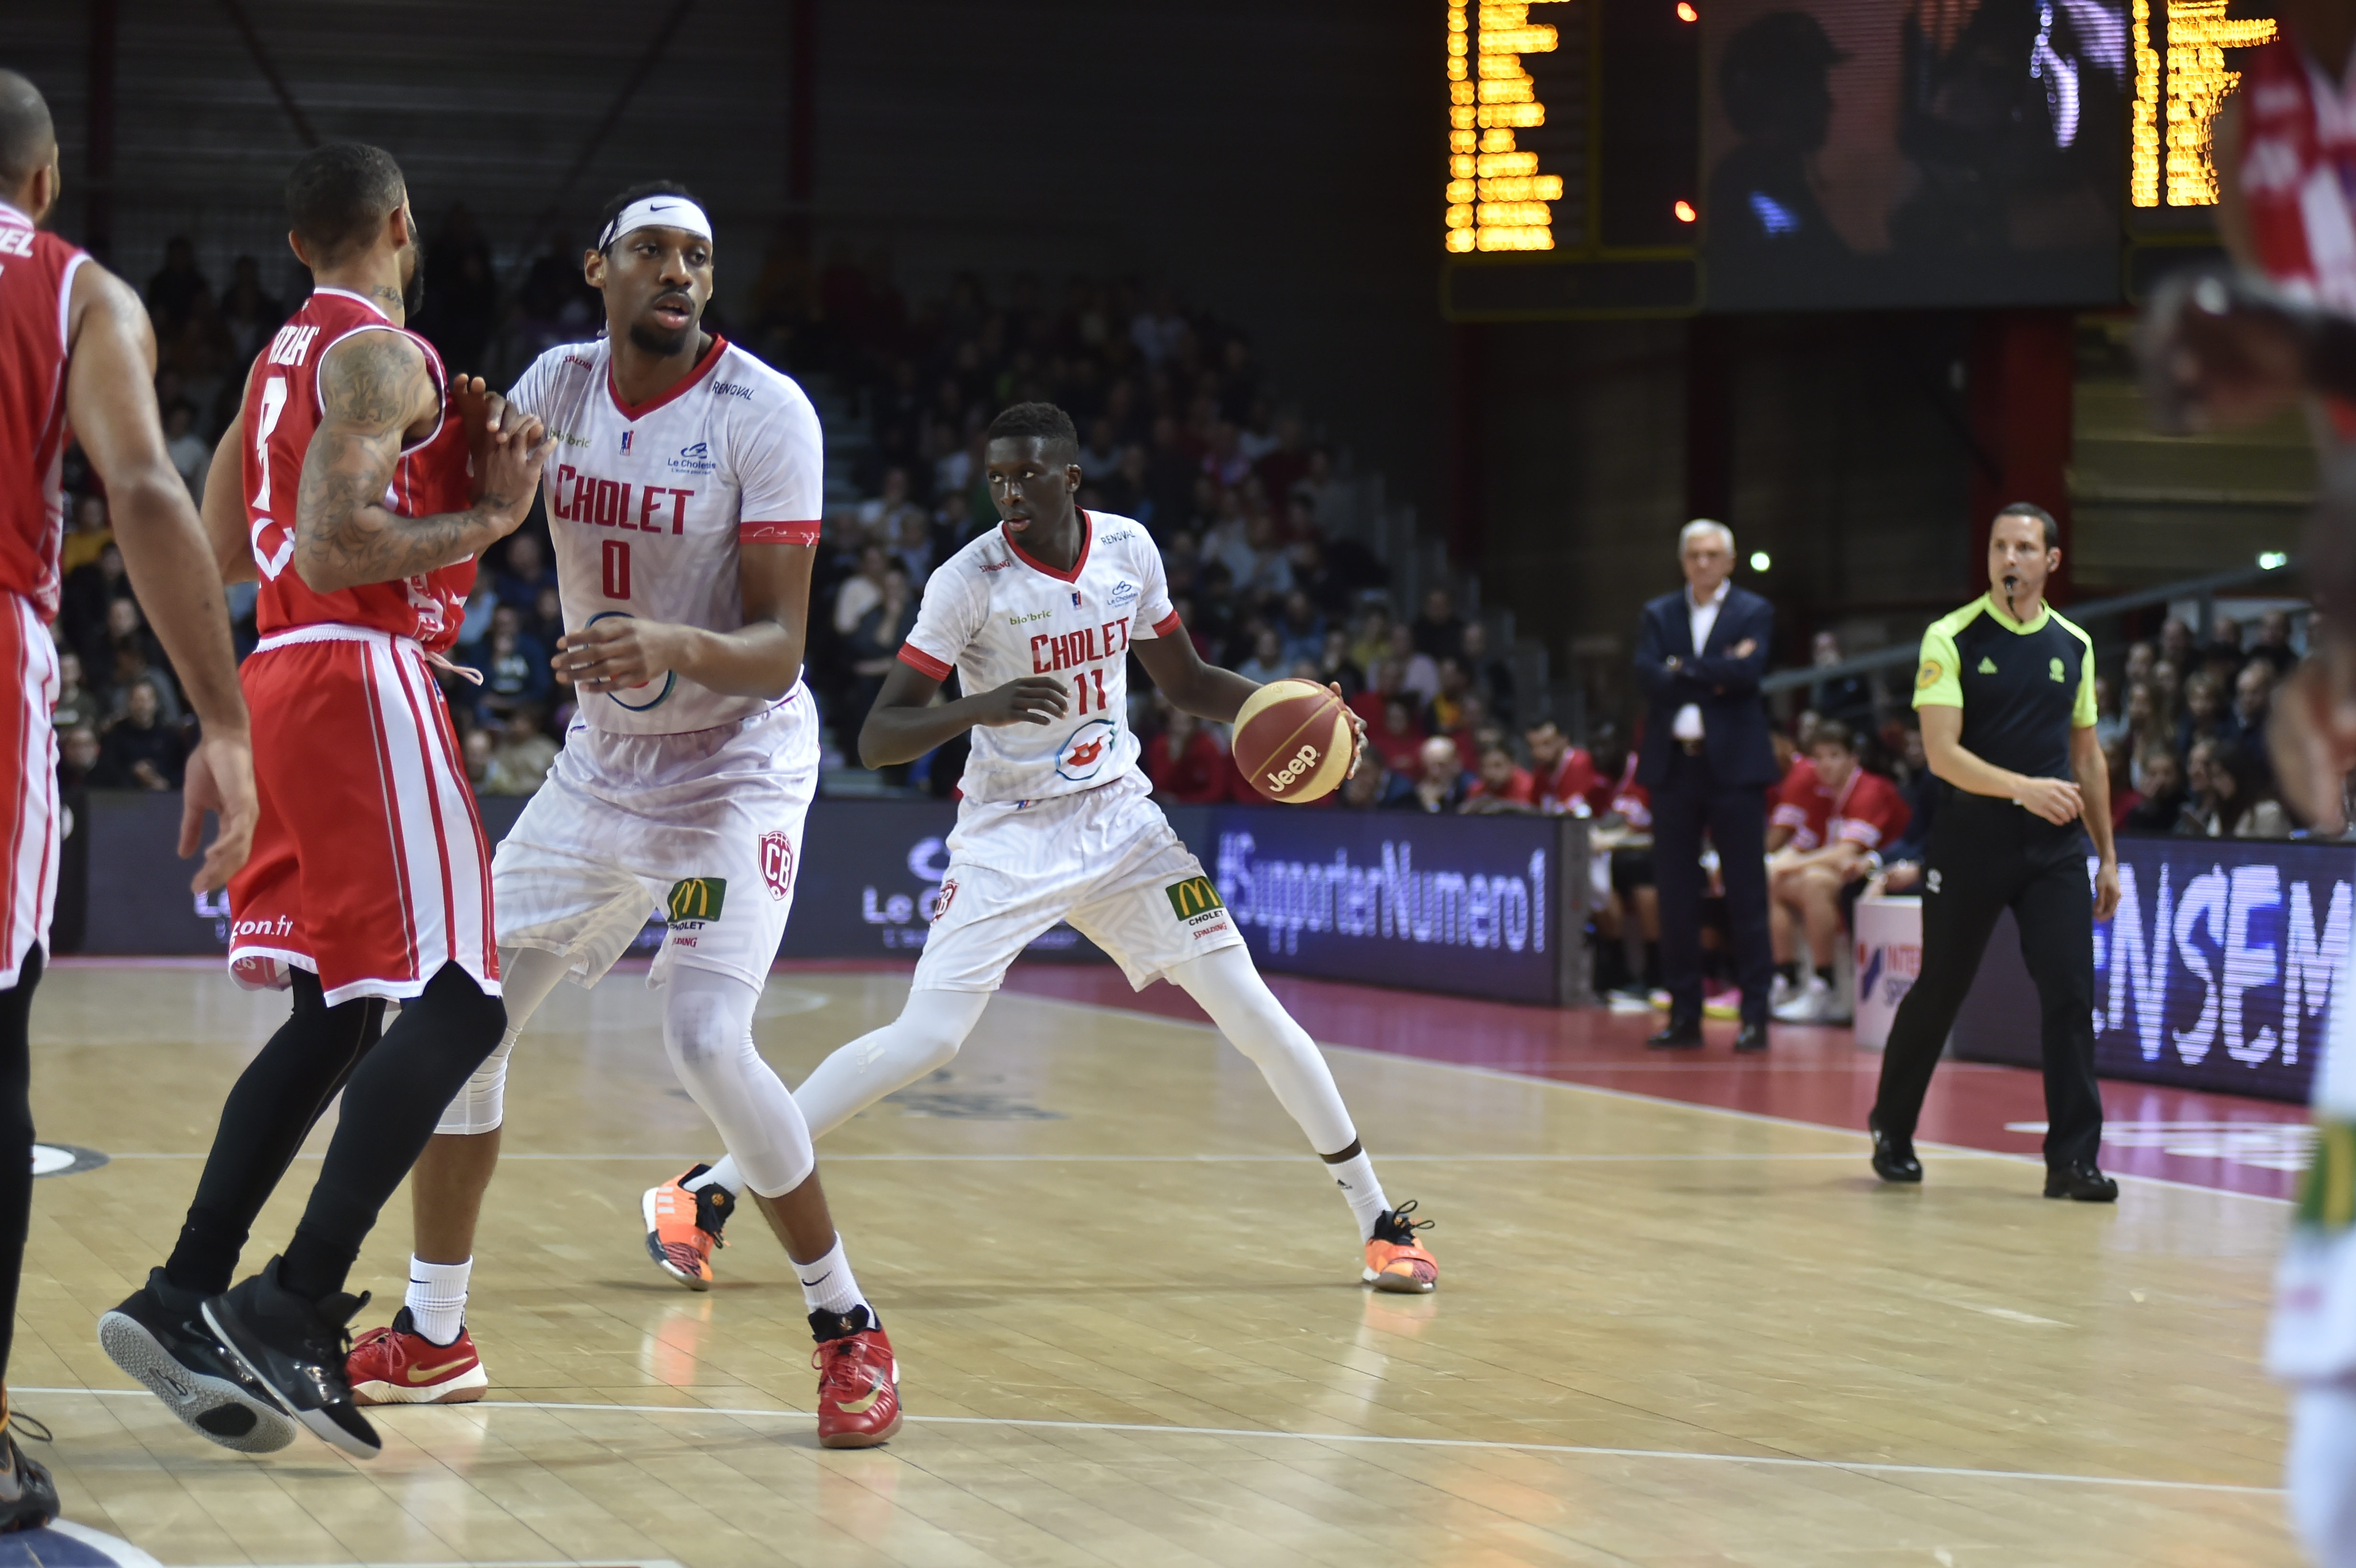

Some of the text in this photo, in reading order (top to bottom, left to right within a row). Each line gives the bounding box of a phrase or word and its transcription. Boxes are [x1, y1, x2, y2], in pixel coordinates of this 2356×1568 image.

[563, 355, 593, 372] SPALDIN
[667, 457, 679, 467] Le
[554, 463, 695, 535] CHOLET
[602, 539, 631, 600] 0
[979, 559, 1011, 573] SPALDING
[1030, 616, 1129, 675] CHOLET
[1073, 668, 1107, 716] 11
[1267, 744, 1318, 793] Jeep
[765, 842, 791, 890] CB
[1188, 910, 1224, 926] CHOLET
[1193, 922, 1227, 940] SPALDING
